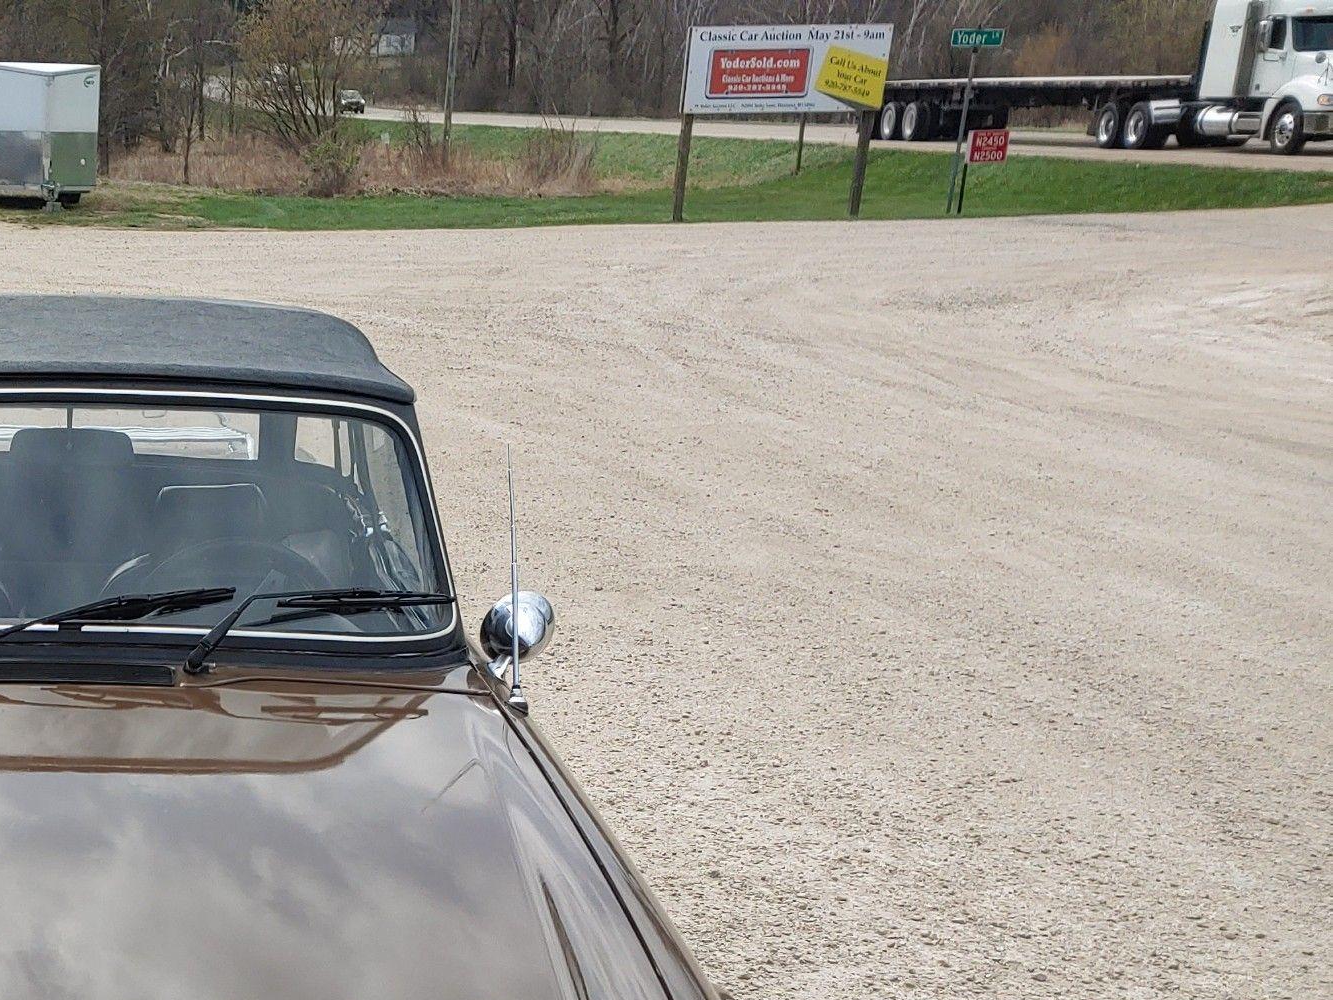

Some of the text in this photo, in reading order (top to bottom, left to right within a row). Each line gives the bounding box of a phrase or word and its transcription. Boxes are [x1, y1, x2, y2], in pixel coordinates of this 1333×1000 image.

[699, 30, 737, 41] Classic
[740, 30, 758, 41] Car
[761, 30, 802, 41] Auction
[807, 30, 831, 42] May
[833, 30, 854, 40] 21st
[863, 29, 885, 40] 9am
[957, 31, 987, 45] Yoder
[720, 57, 800, 69] YoderSold.com
[830, 56, 846, 67] Call
[857, 63, 882, 77] About
[837, 70, 867, 85] Your Car
[976, 135, 1005, 147] N2450
[973, 150, 1003, 161] N2500
